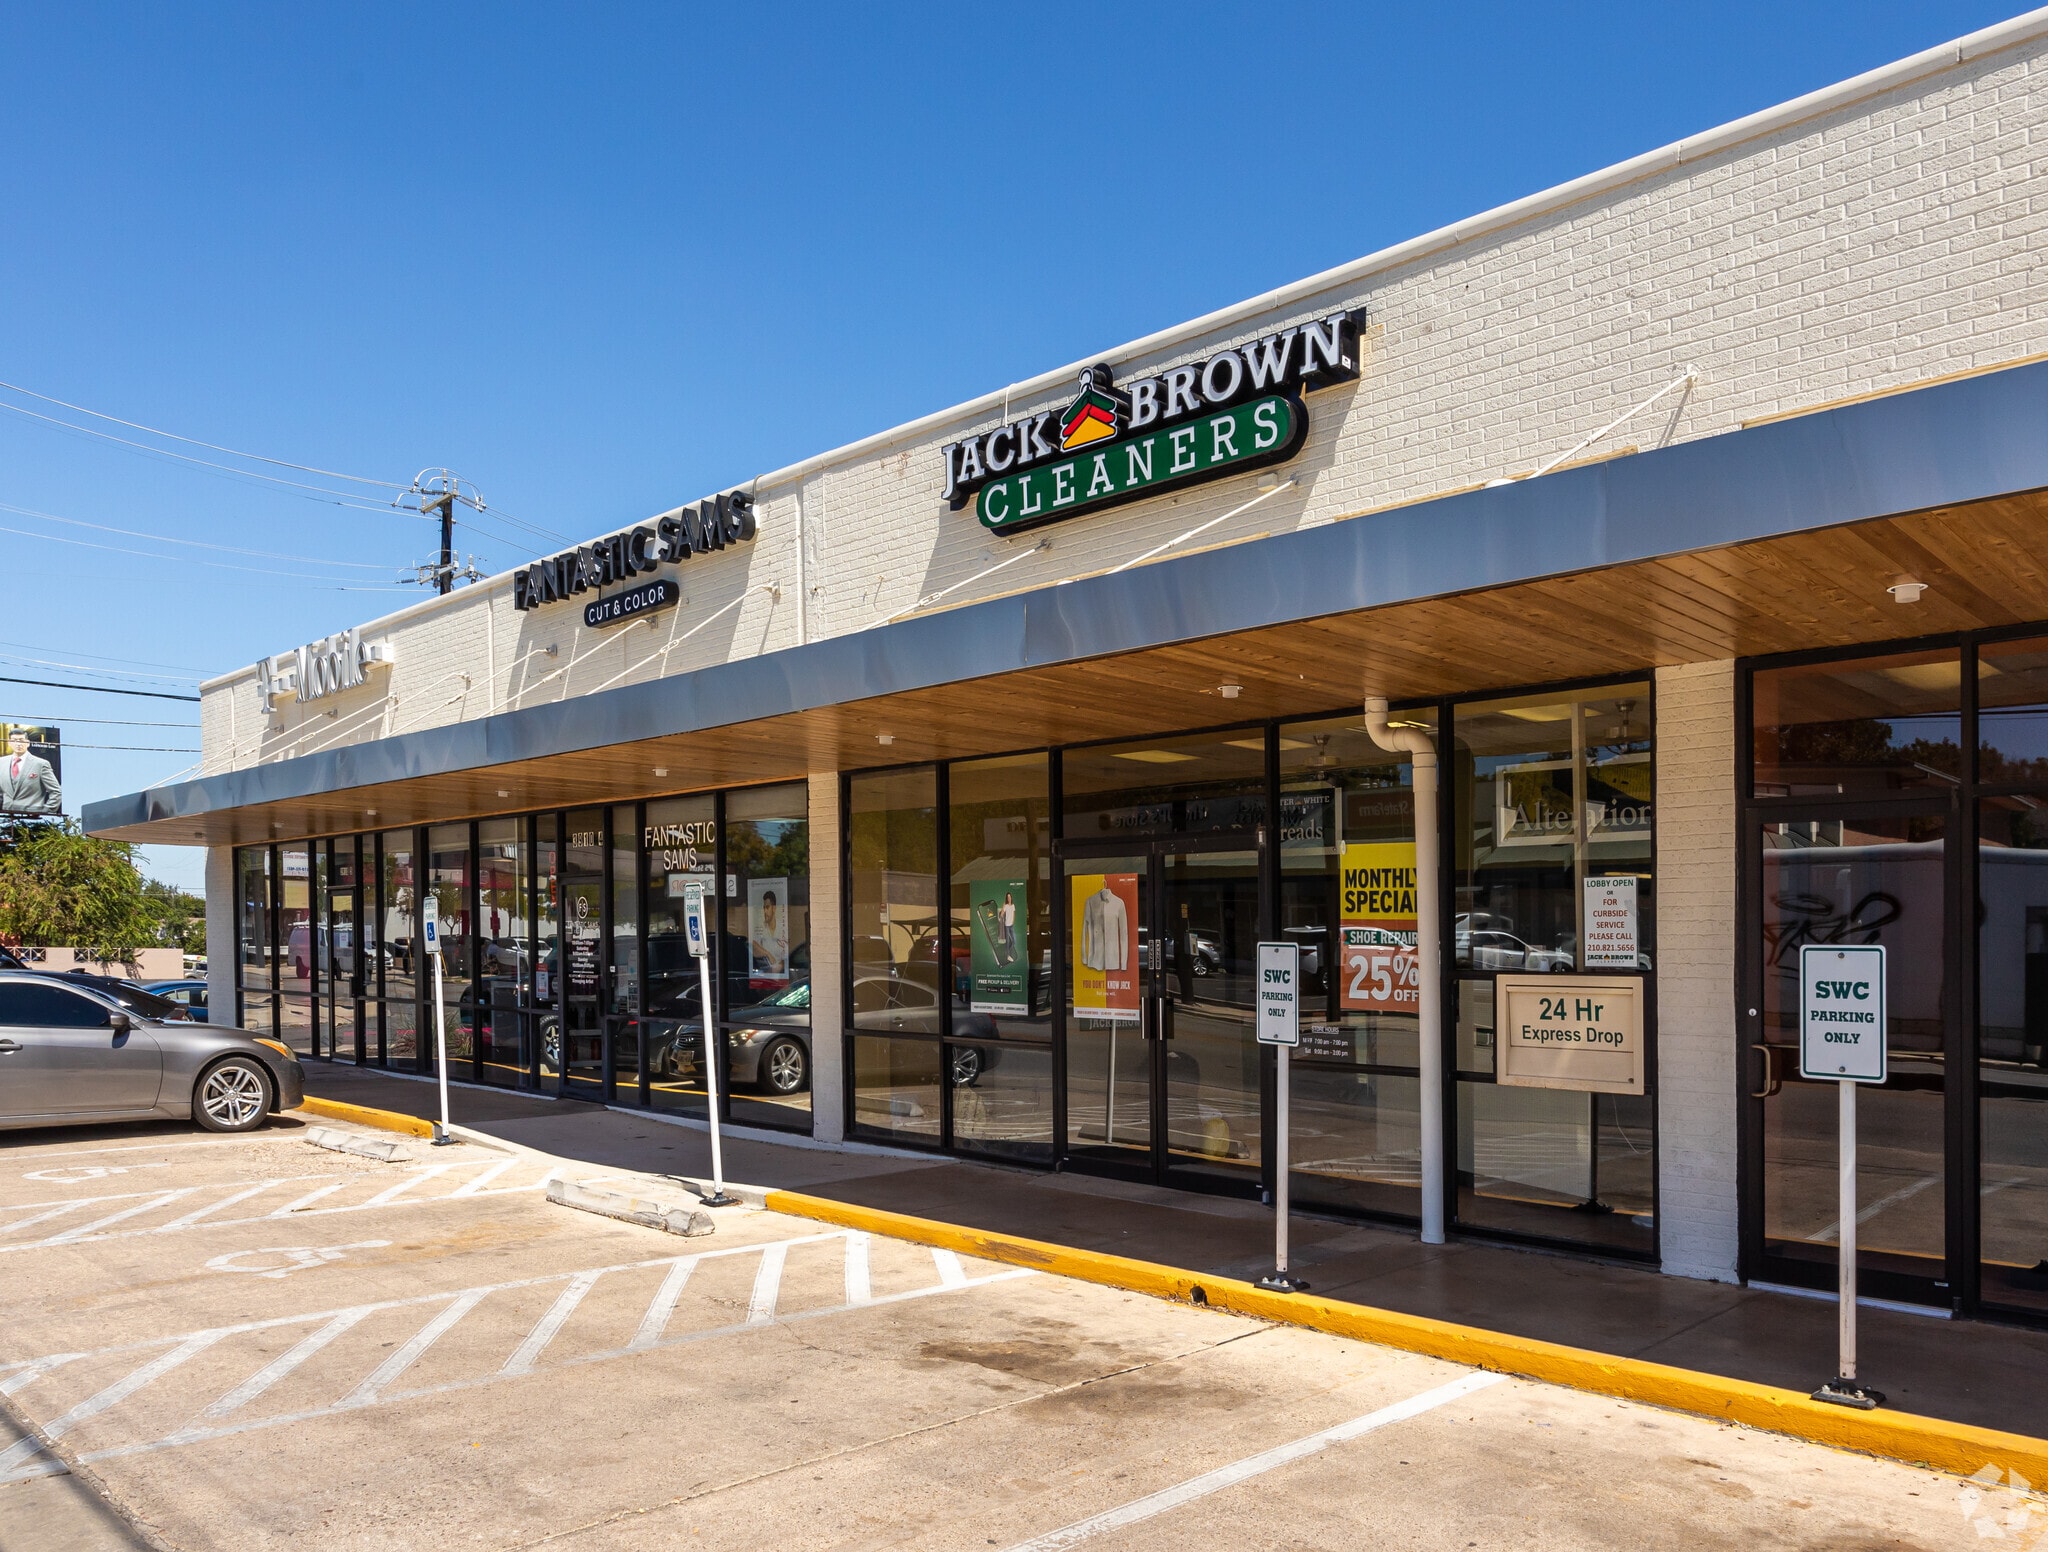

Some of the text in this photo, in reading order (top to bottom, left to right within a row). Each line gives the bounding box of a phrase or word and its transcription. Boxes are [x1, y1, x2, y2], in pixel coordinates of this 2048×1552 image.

[941, 311, 1350, 500] JACK BROWN
[984, 401, 1278, 523] CLEANERS
[515, 491, 756, 611] FANTASTIC SAMS
[588, 586, 665, 623] CUT & COLOR
[644, 821, 715, 848] FANTASTIC
[663, 847, 697, 871] SAMS
[1586, 879, 1634, 888] LOBBY OPEN
[1603, 898, 1618, 906] FOR
[1592, 909, 1628, 917] CURBSIDE
[1596, 921, 1625, 929] SERVICE
[1350, 931, 1377, 944] SHOE
[1589, 932, 1633, 940] PLEASE CALL
[1587, 944, 1635, 952] 210.821.5656
[1264, 969, 1291, 984] SWC
[1349, 955, 1419, 1001] 25%
[1107, 980, 1120, 990] KNOW
[1120, 980, 1131, 990] JACK
[1815, 980, 1869, 1000] SWC
[1261, 991, 1293, 1001] PARKING
[1394, 990, 1419, 1002] OFF
[1268, 1008, 1286, 1017] ONLY
[1539, 998, 1604, 1022] 24 Hr
[1811, 1010, 1875, 1024] PARKING
[1522, 1025, 1624, 1047] Express Drop
[1824, 1032, 1861, 1044] ONLY
